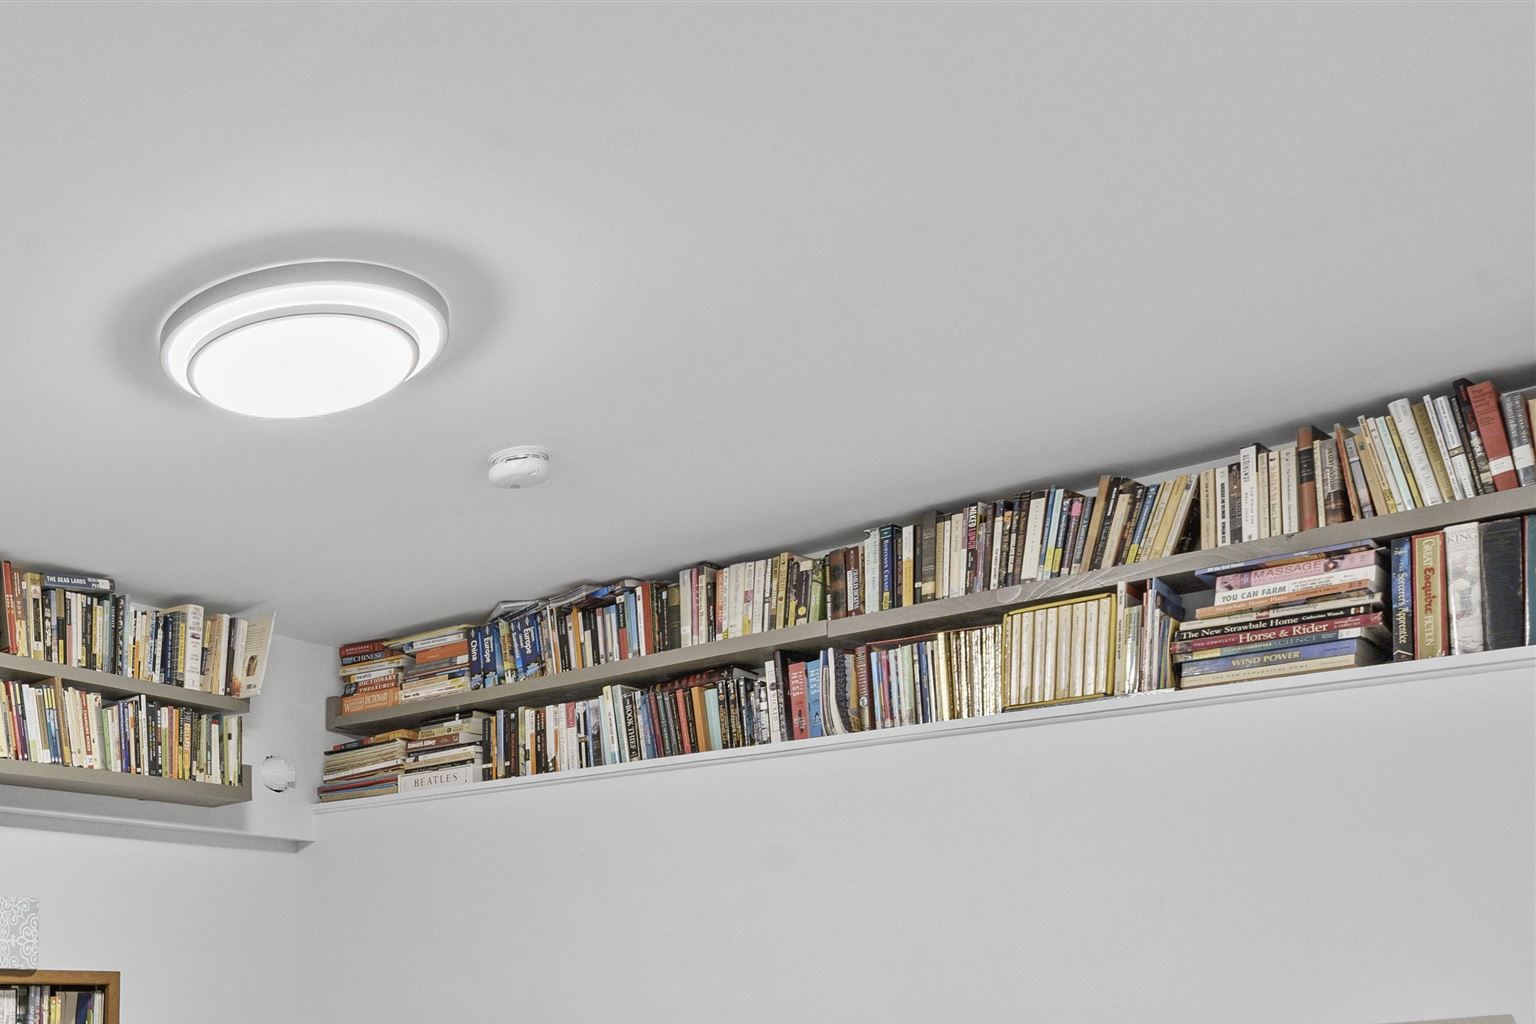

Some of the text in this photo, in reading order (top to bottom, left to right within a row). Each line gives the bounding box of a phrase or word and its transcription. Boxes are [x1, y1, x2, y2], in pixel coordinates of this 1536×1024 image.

[968, 506, 977, 549] NAKED LUNCH
[1448, 533, 1478, 544] KING
[1253, 560, 1322, 579] MASSAGE
[1221, 585, 1287, 603] YOU CAN FARM
[1421, 539, 1437, 645] GREAT Esquire FICTION
[1180, 630, 1201, 640] The
[1203, 627, 1222, 636] New
[1224, 620, 1267, 633] Strawbale
[1269, 616, 1299, 627] Home
[1238, 630, 1275, 644] Horse
[1279, 628, 1288, 637] &
[1292, 622, 1328, 635] Rider
[1397, 608, 1407, 644] Apprentice
[524, 628, 532, 654] Europe
[1231, 650, 1301, 667] WIND POWER
[791, 672, 799, 697] NESS
[625, 704, 637, 750] BOOK THIEF
[414, 773, 458, 788] BEATLES
